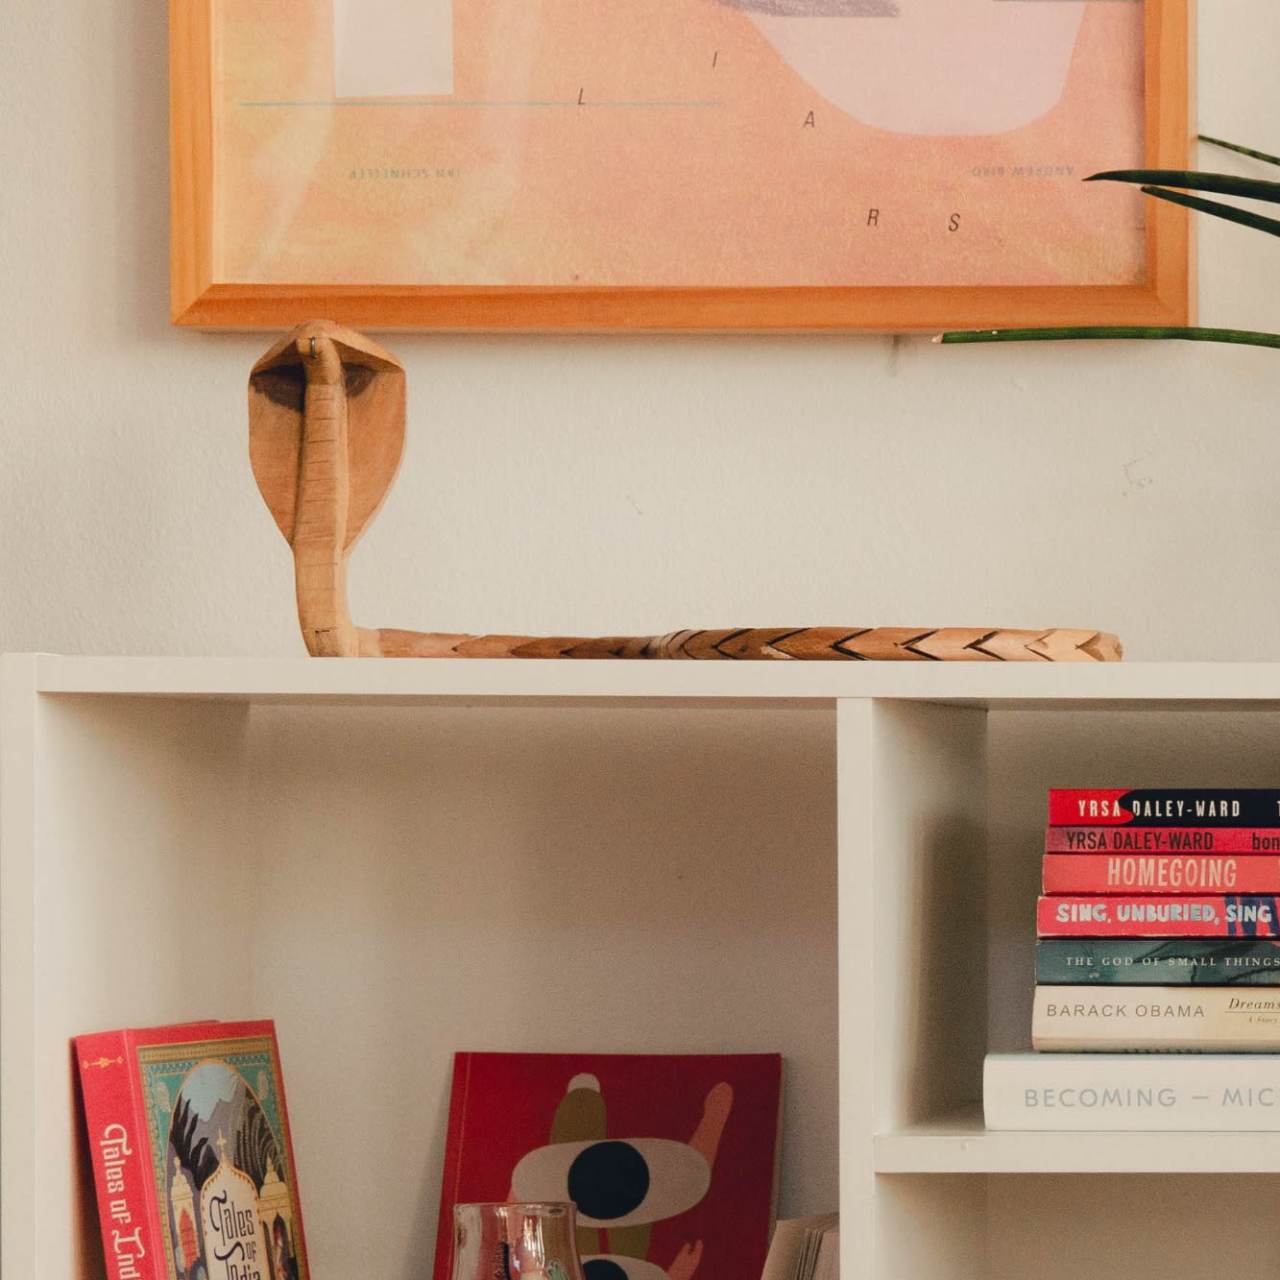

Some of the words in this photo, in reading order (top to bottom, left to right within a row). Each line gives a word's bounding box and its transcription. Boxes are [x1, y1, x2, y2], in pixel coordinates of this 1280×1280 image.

[1078, 800, 1121, 817] YRSA
[1133, 800, 1240, 817] DALEY-WARD
[1067, 832, 1107, 849] YRSA
[1113, 832, 1213, 850] DALEY-WARD
[1107, 858, 1237, 887] HOMEGOING
[1056, 903, 1111, 923] SING,
[1117, 904, 1220, 925] UNBURIED,
[1226, 905, 1272, 922] SING
[1047, 1005, 1127, 1017] BARACK
[1135, 1005, 1205, 1017] OBAMA
[1024, 1089, 1176, 1108] BECOMING
